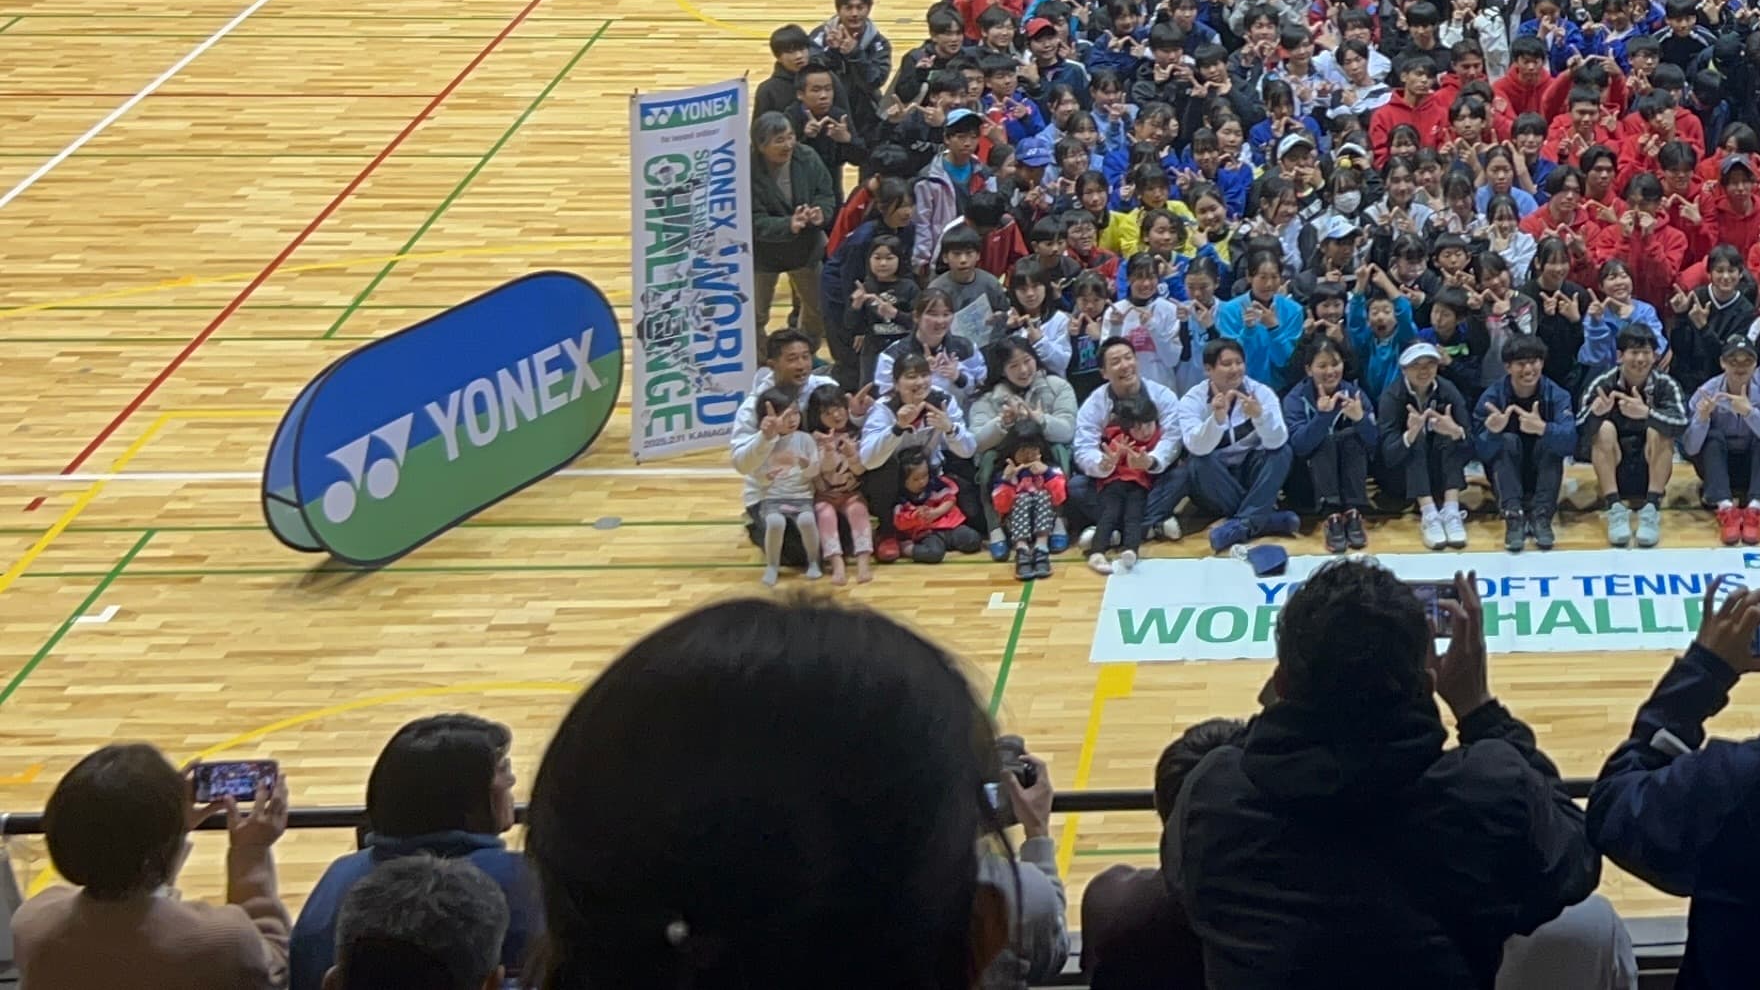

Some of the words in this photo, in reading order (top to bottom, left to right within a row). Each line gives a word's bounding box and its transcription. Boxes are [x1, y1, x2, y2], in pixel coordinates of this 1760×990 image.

[678, 94, 733, 121] YONEX
[708, 138, 737, 230] YONEX
[425, 327, 601, 462] YONEX
[1572, 572, 1747, 596] TENNIS
